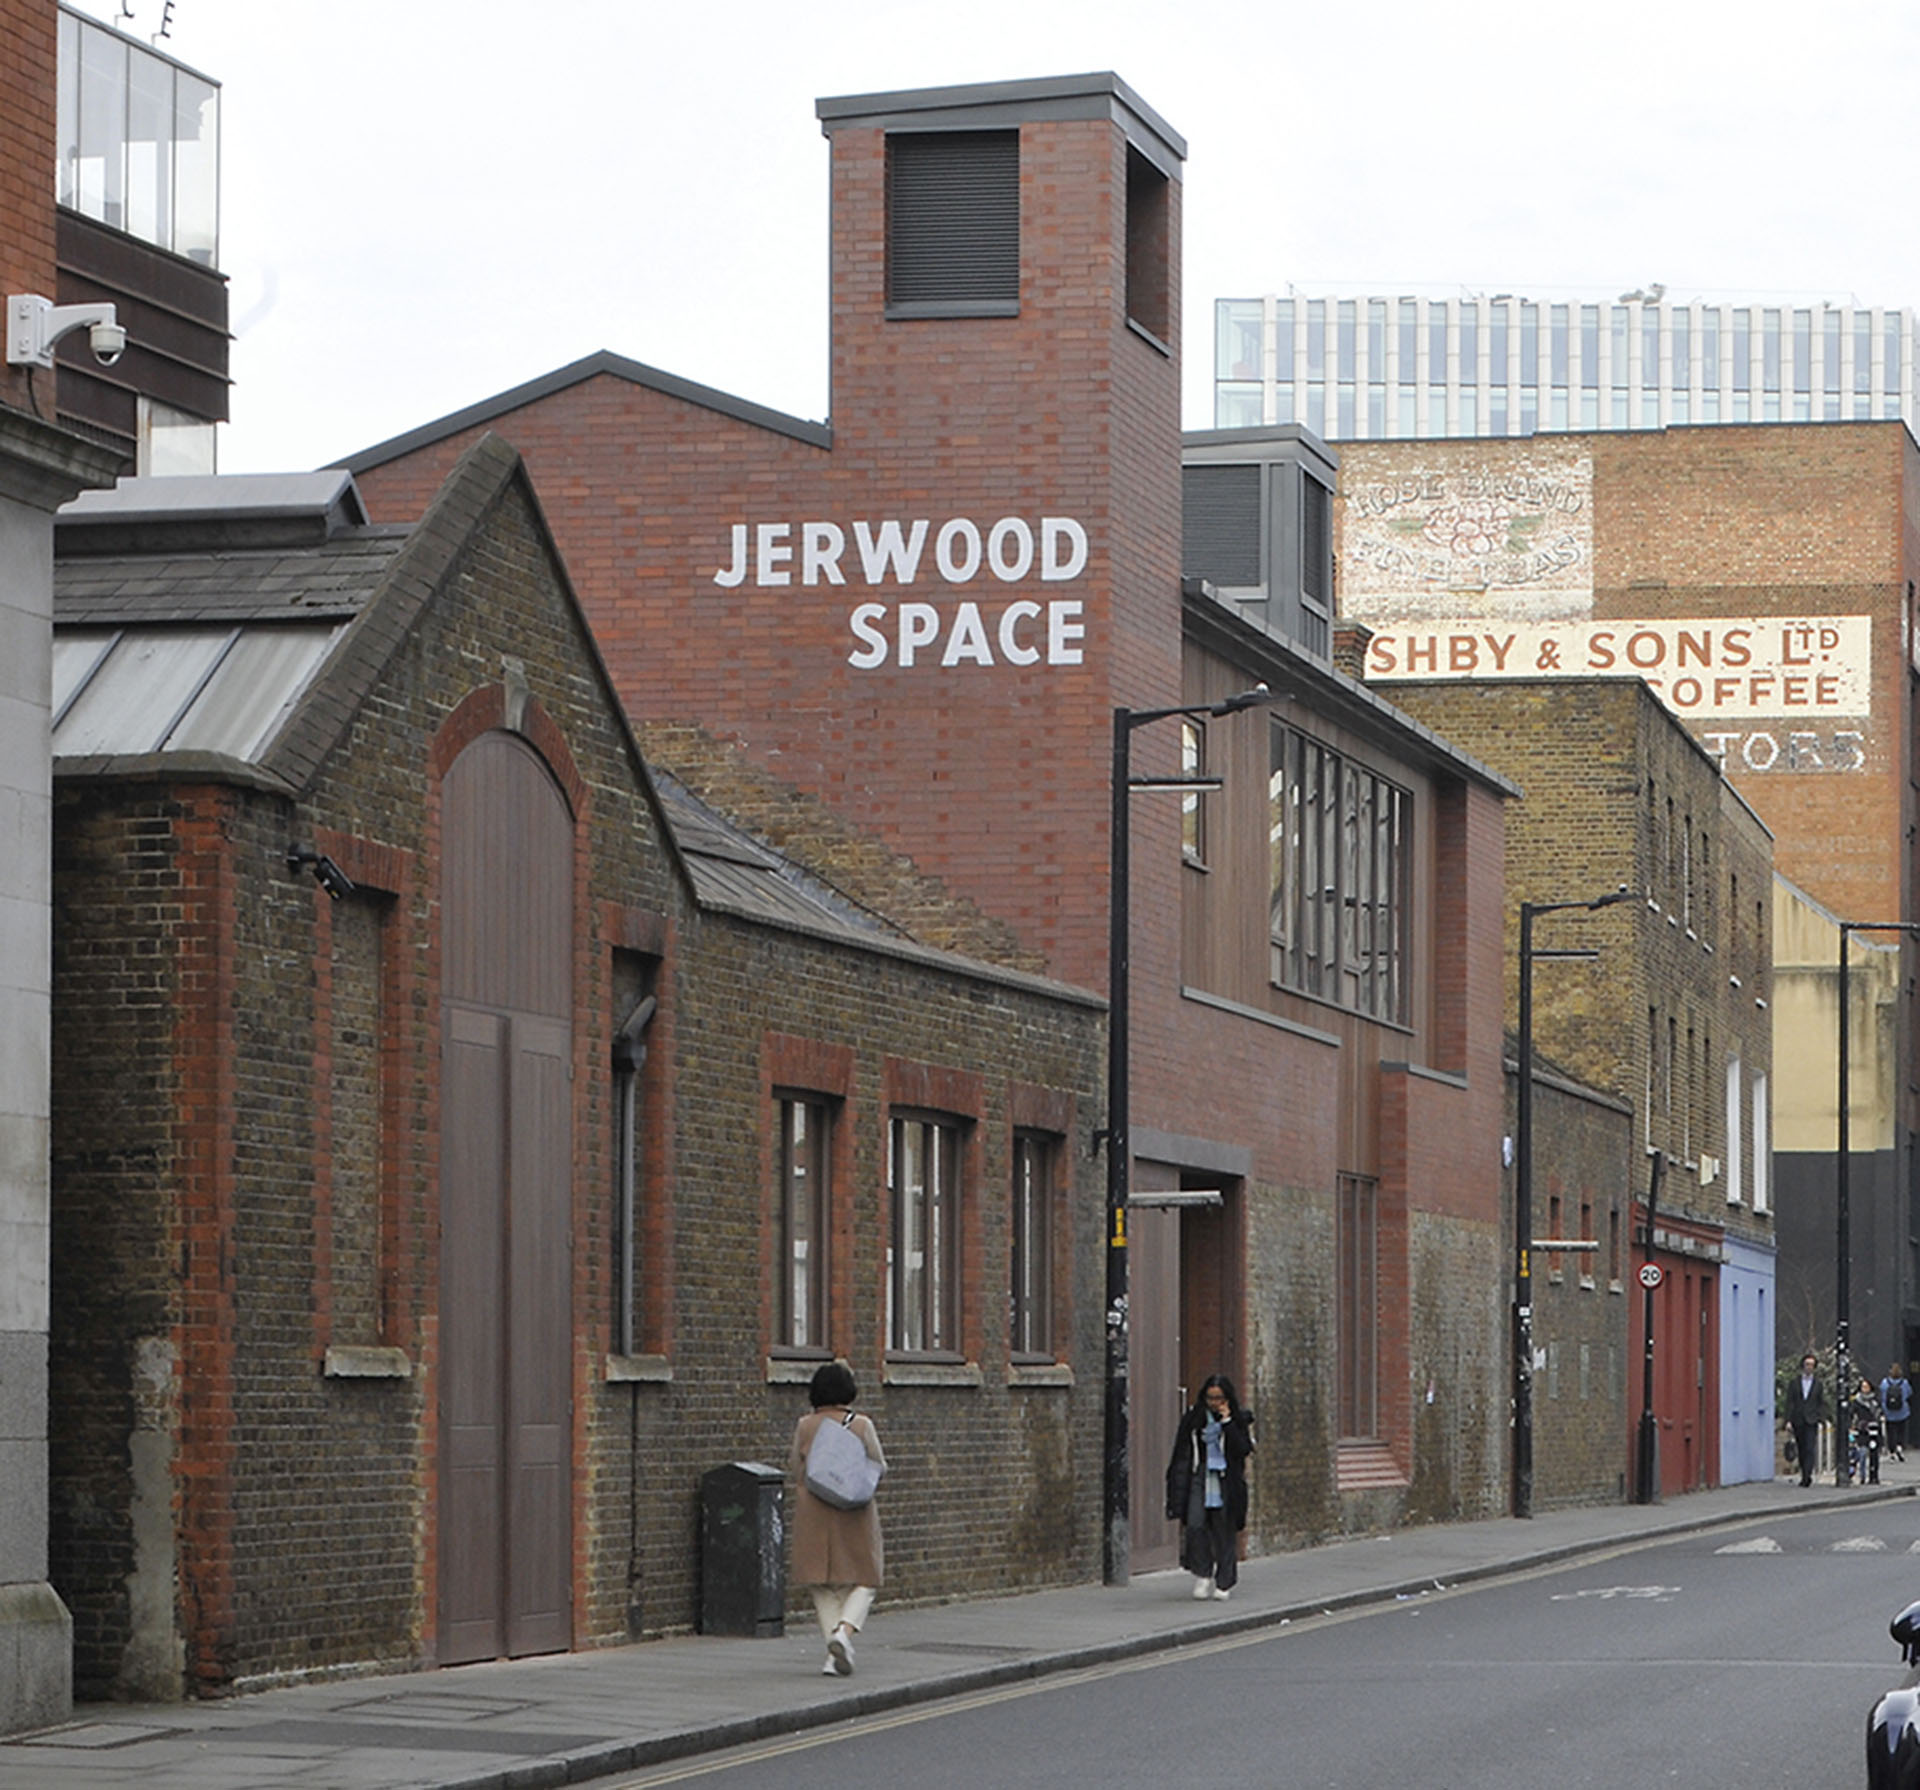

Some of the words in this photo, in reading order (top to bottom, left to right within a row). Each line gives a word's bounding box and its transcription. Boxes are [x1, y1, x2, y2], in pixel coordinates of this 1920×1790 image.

[713, 516, 1089, 587] JERWOOD
[848, 600, 1085, 669] SPACE
[1535, 638, 1561, 670] &
[1587, 629, 1753, 669] SONS
[1642, 1268, 1660, 1282] 20
